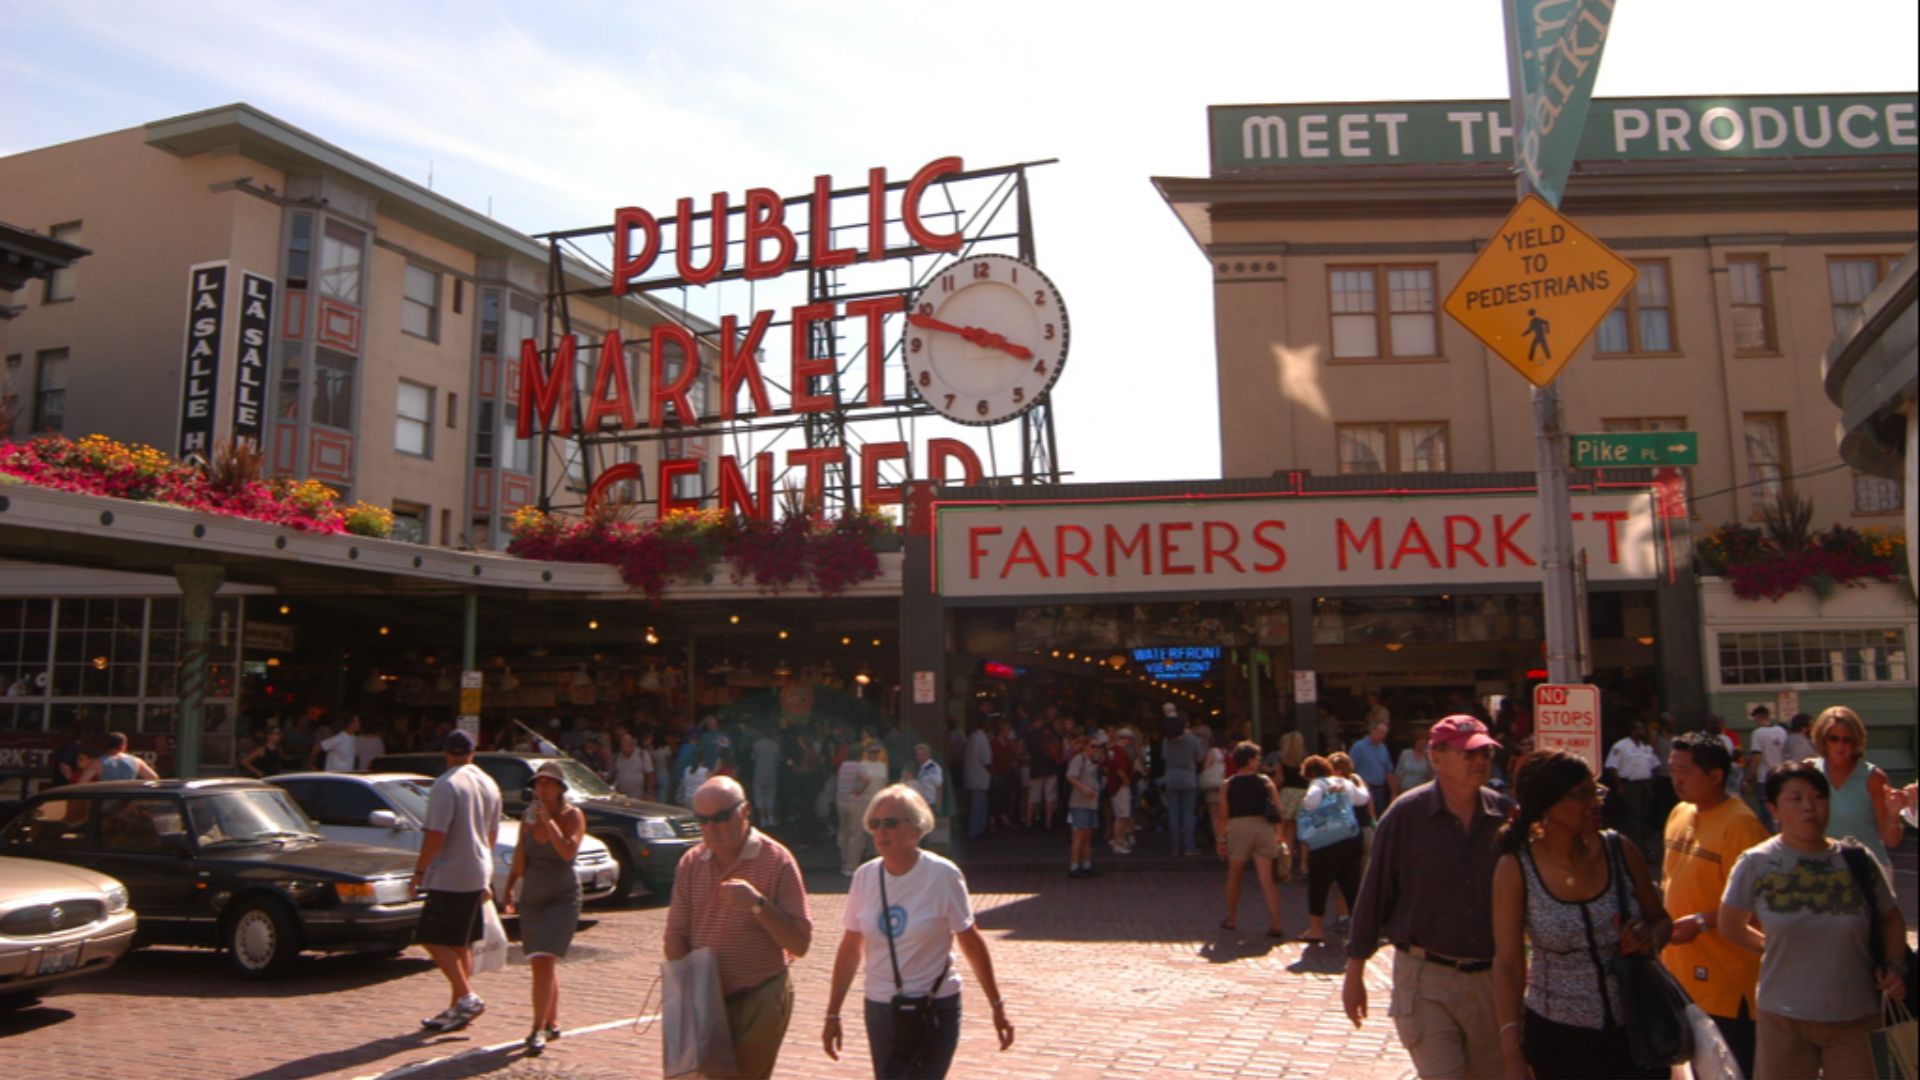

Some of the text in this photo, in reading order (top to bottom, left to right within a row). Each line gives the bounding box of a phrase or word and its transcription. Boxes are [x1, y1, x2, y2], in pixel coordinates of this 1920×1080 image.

[1242, 112, 1408, 159] MEET
[1613, 102, 1918, 153] PRODUCE
[614, 156, 963, 295] PUBLIC
[1503, 224, 1566, 251] YIELD
[974, 262, 989, 279] 12
[1521, 253, 1548, 274] TO
[943, 275, 954, 292] 11
[1012, 268, 1018, 283] 1
[1035, 290, 1046, 306] 2
[1465, 270, 1610, 311] PEDESTRIANS
[1044, 324, 1054, 340] 3
[911, 337, 922, 353] 9
[515, 295, 906, 440] MARKET
[1034, 359, 1047, 376] 4
[919, 371, 930, 387] 8
[944, 394, 956, 409] 7
[1013, 387, 1024, 402] 5
[977, 400, 989, 415] 6
[1578, 441, 1628, 461] Pike
[968, 511, 1629, 579] FARMERS MARKT
[1541, 689, 1564, 704] NO
[1541, 711, 1592, 726] STOPS
